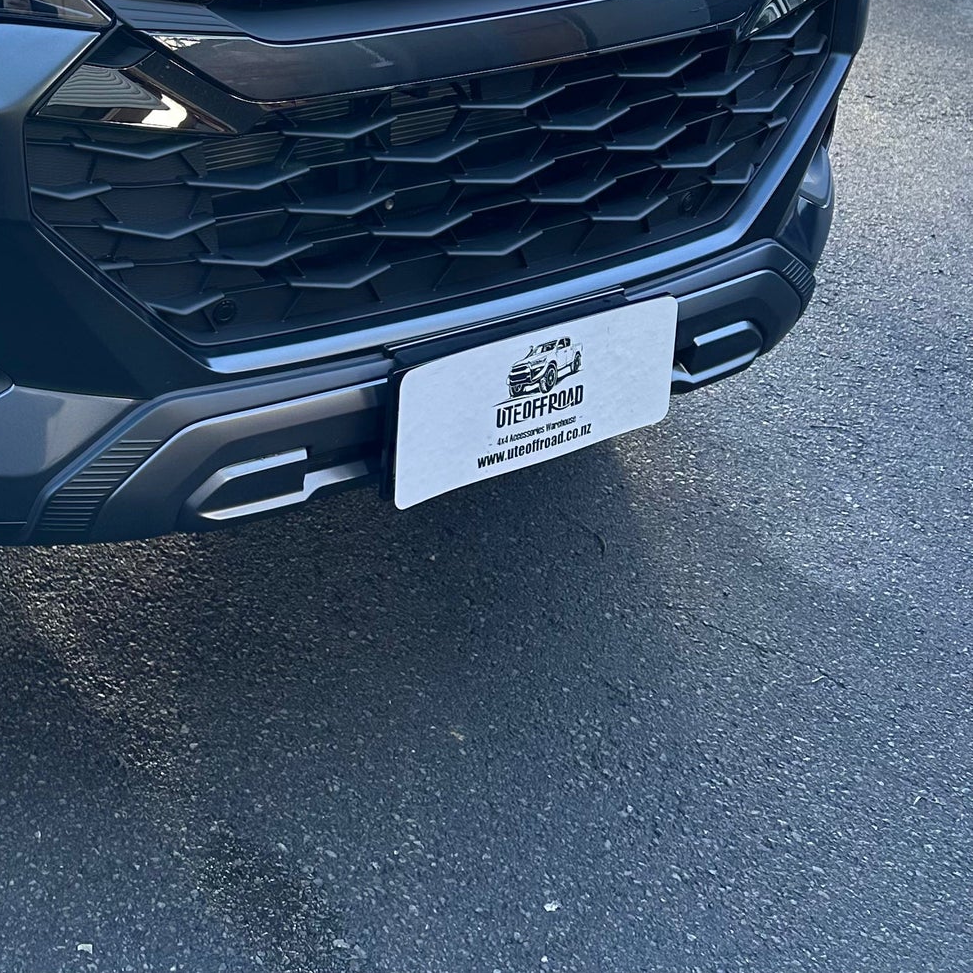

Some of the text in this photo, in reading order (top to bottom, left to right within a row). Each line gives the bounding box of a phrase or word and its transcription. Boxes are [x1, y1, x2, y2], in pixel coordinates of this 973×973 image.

[496, 385, 584, 428] UTEOFFROAD
[477, 423, 592, 469] www.uteoffroad.co.nz
[497, 415, 577, 446] 4x4 Accessories Warehouse
